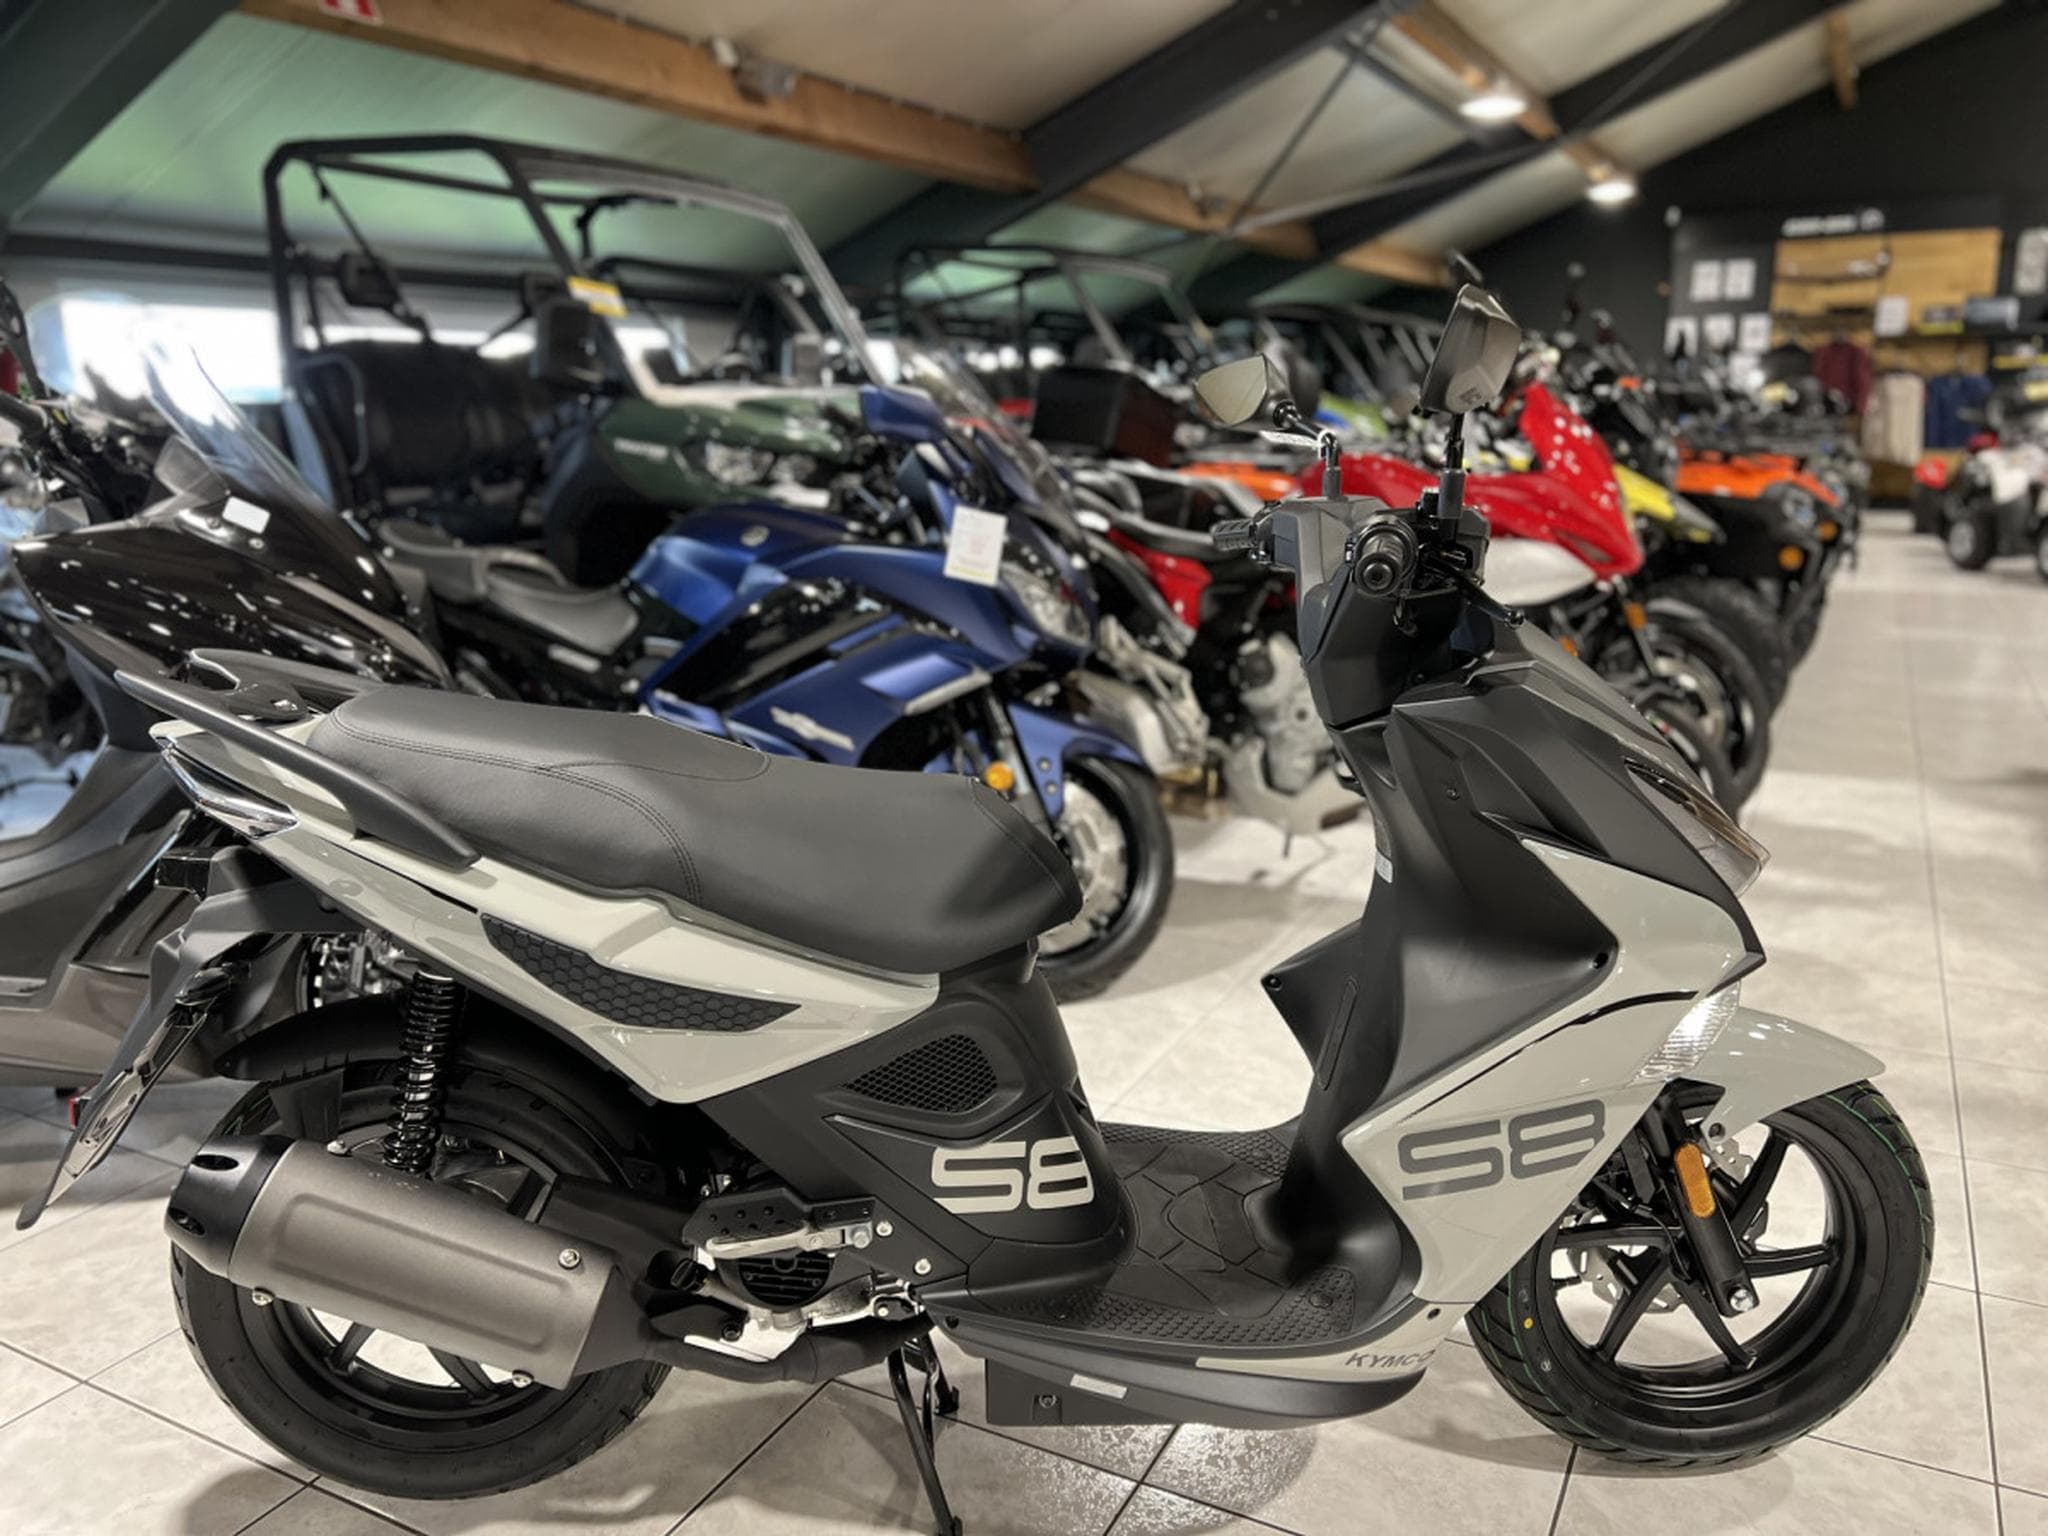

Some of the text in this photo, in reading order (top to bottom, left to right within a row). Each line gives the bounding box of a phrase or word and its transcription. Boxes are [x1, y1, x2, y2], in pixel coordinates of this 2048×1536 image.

[931, 1135, 1095, 1215] S8
[1398, 1098, 1606, 1201] S8
[1344, 1349, 1436, 1369] KYMCO
